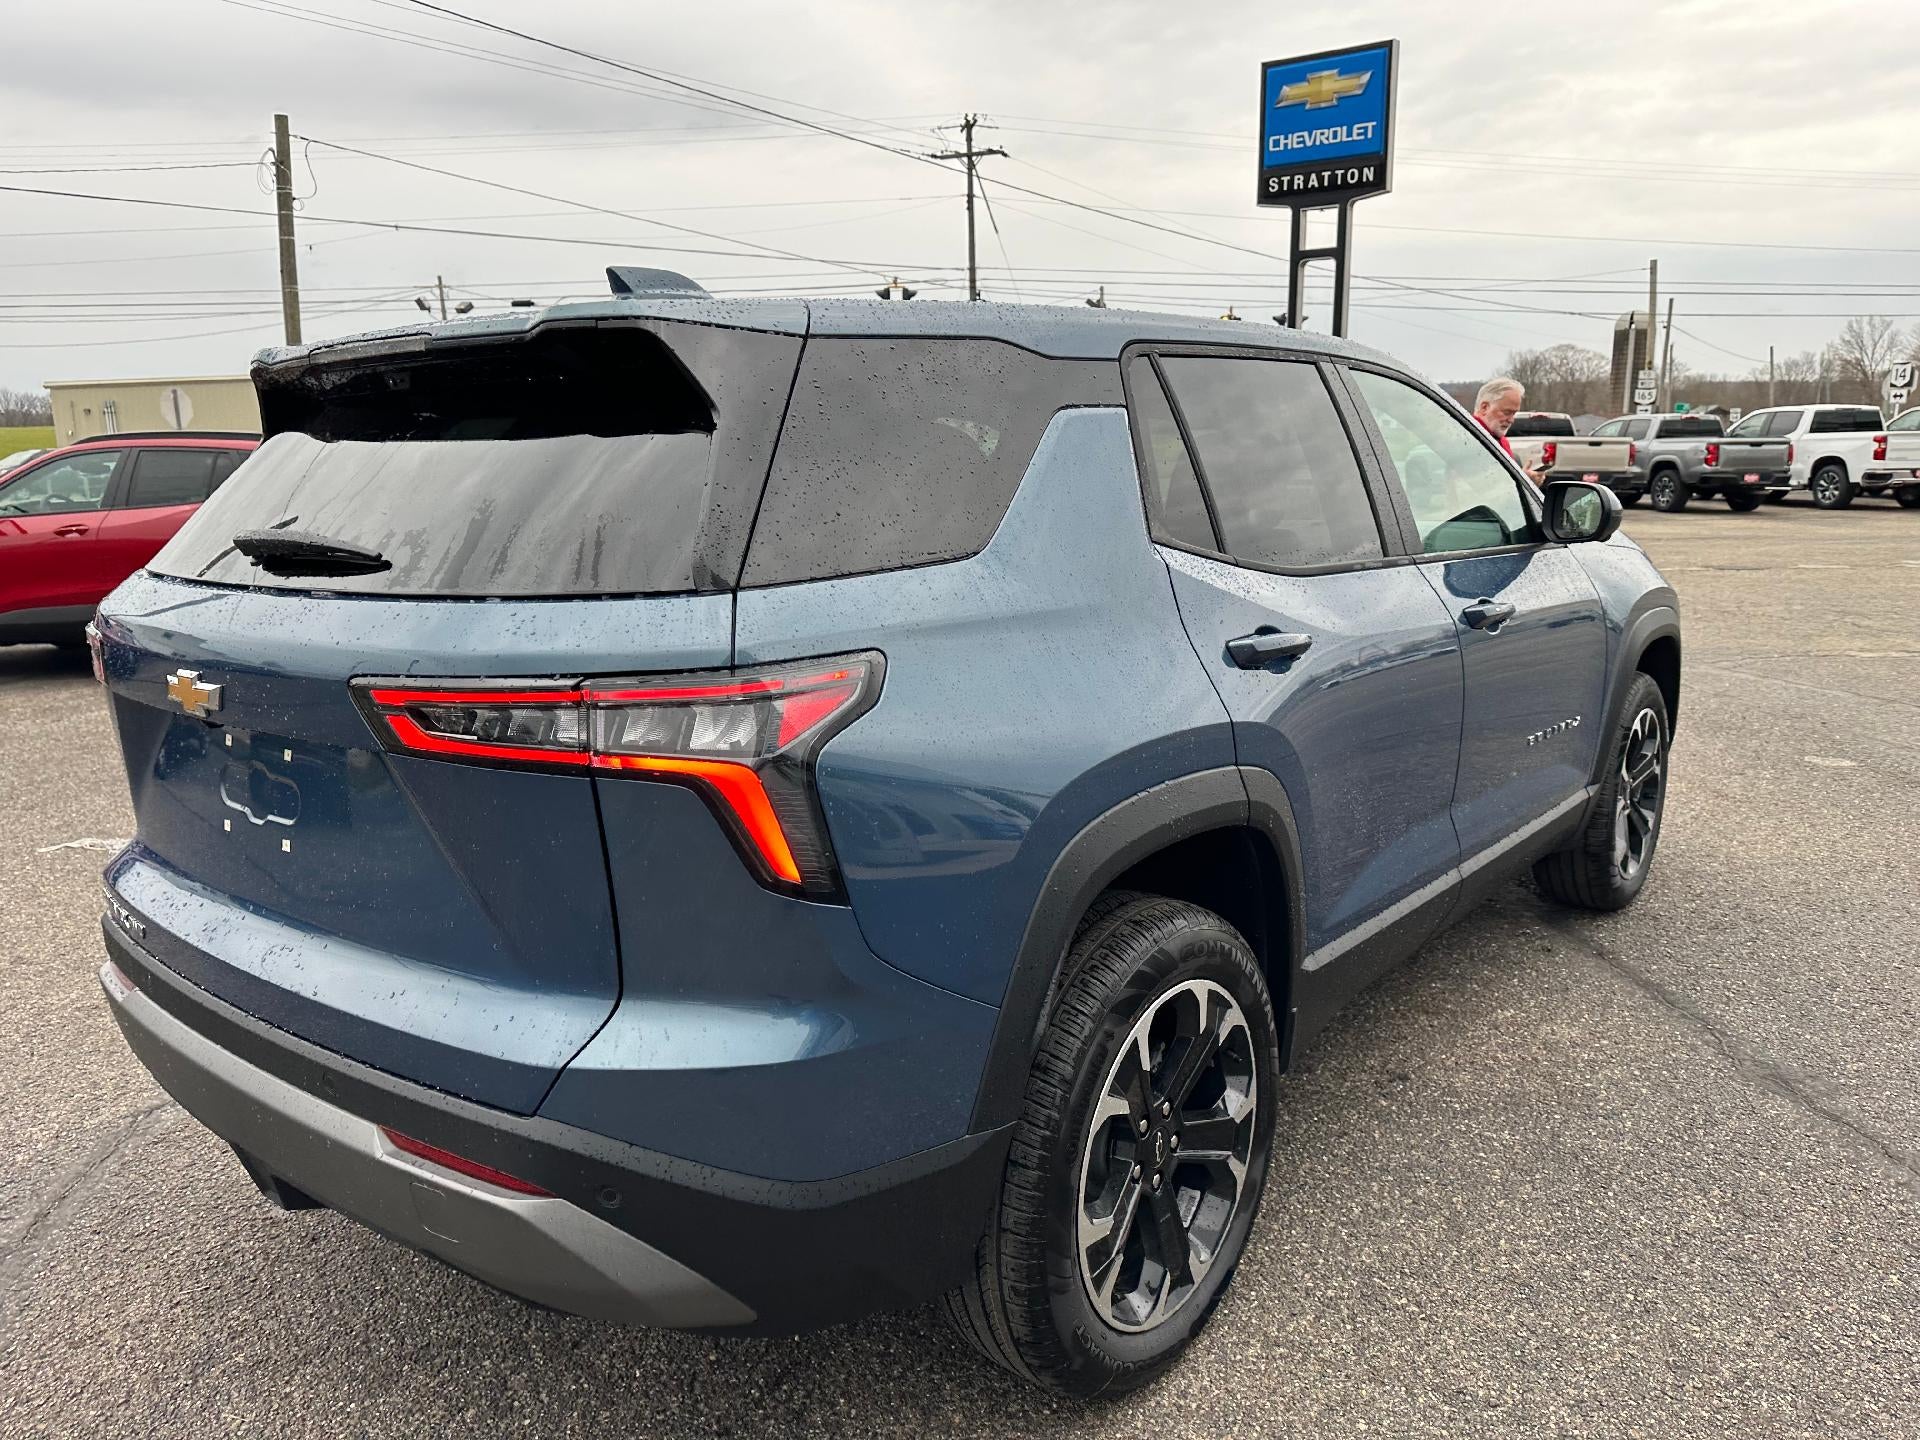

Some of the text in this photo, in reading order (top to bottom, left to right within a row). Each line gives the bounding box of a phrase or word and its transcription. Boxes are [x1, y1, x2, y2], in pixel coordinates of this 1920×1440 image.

[1269, 121, 1377, 151] CHEVROLET
[1268, 166, 1375, 192] STRATTON
[1894, 367, 1907, 381] 14
[1637, 391, 1654, 401] 165
